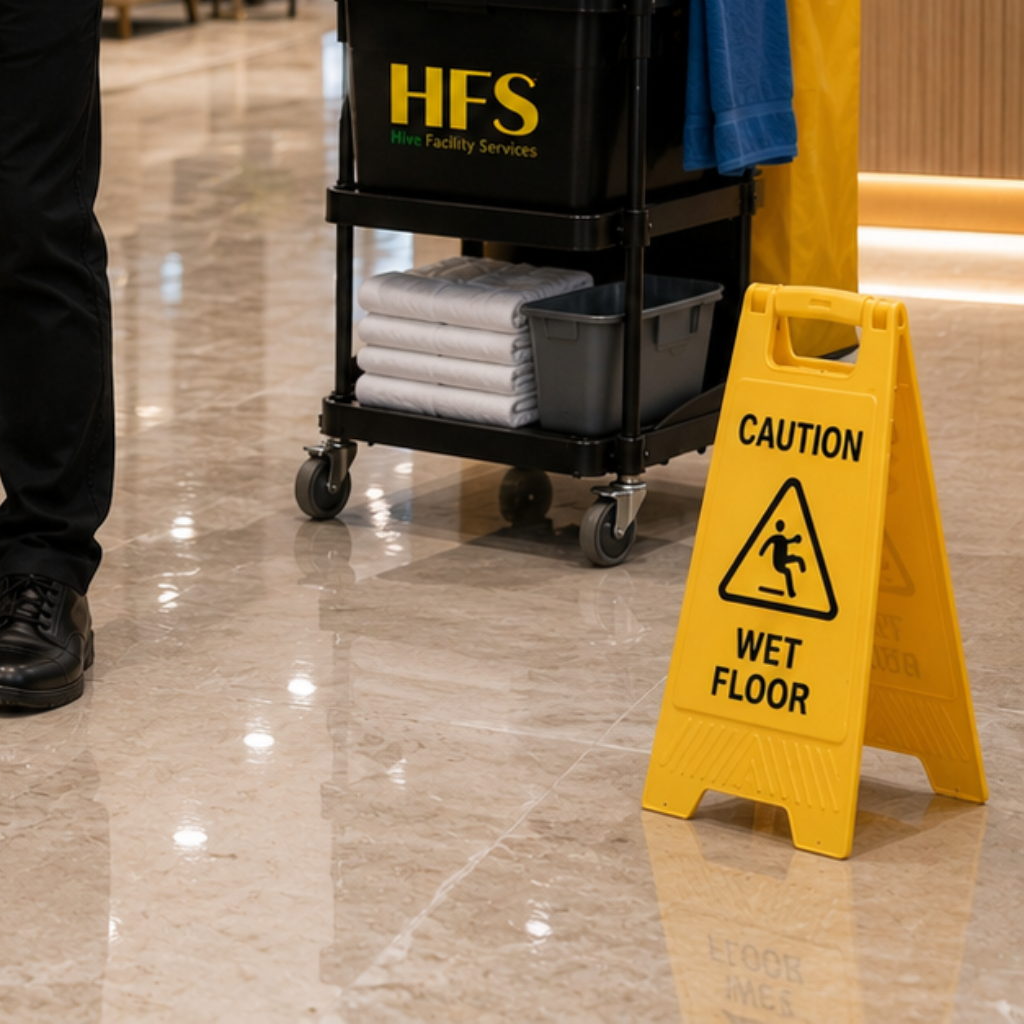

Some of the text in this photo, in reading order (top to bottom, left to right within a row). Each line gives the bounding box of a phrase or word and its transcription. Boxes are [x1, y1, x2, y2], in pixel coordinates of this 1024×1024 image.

[390, 62, 539, 136] HFS
[391, 130, 538, 158] Hive Facility Services
[738, 412, 863, 462] CAUTION
[735, 627, 802, 670] WET
[710, 665, 810, 715] FLOOR
